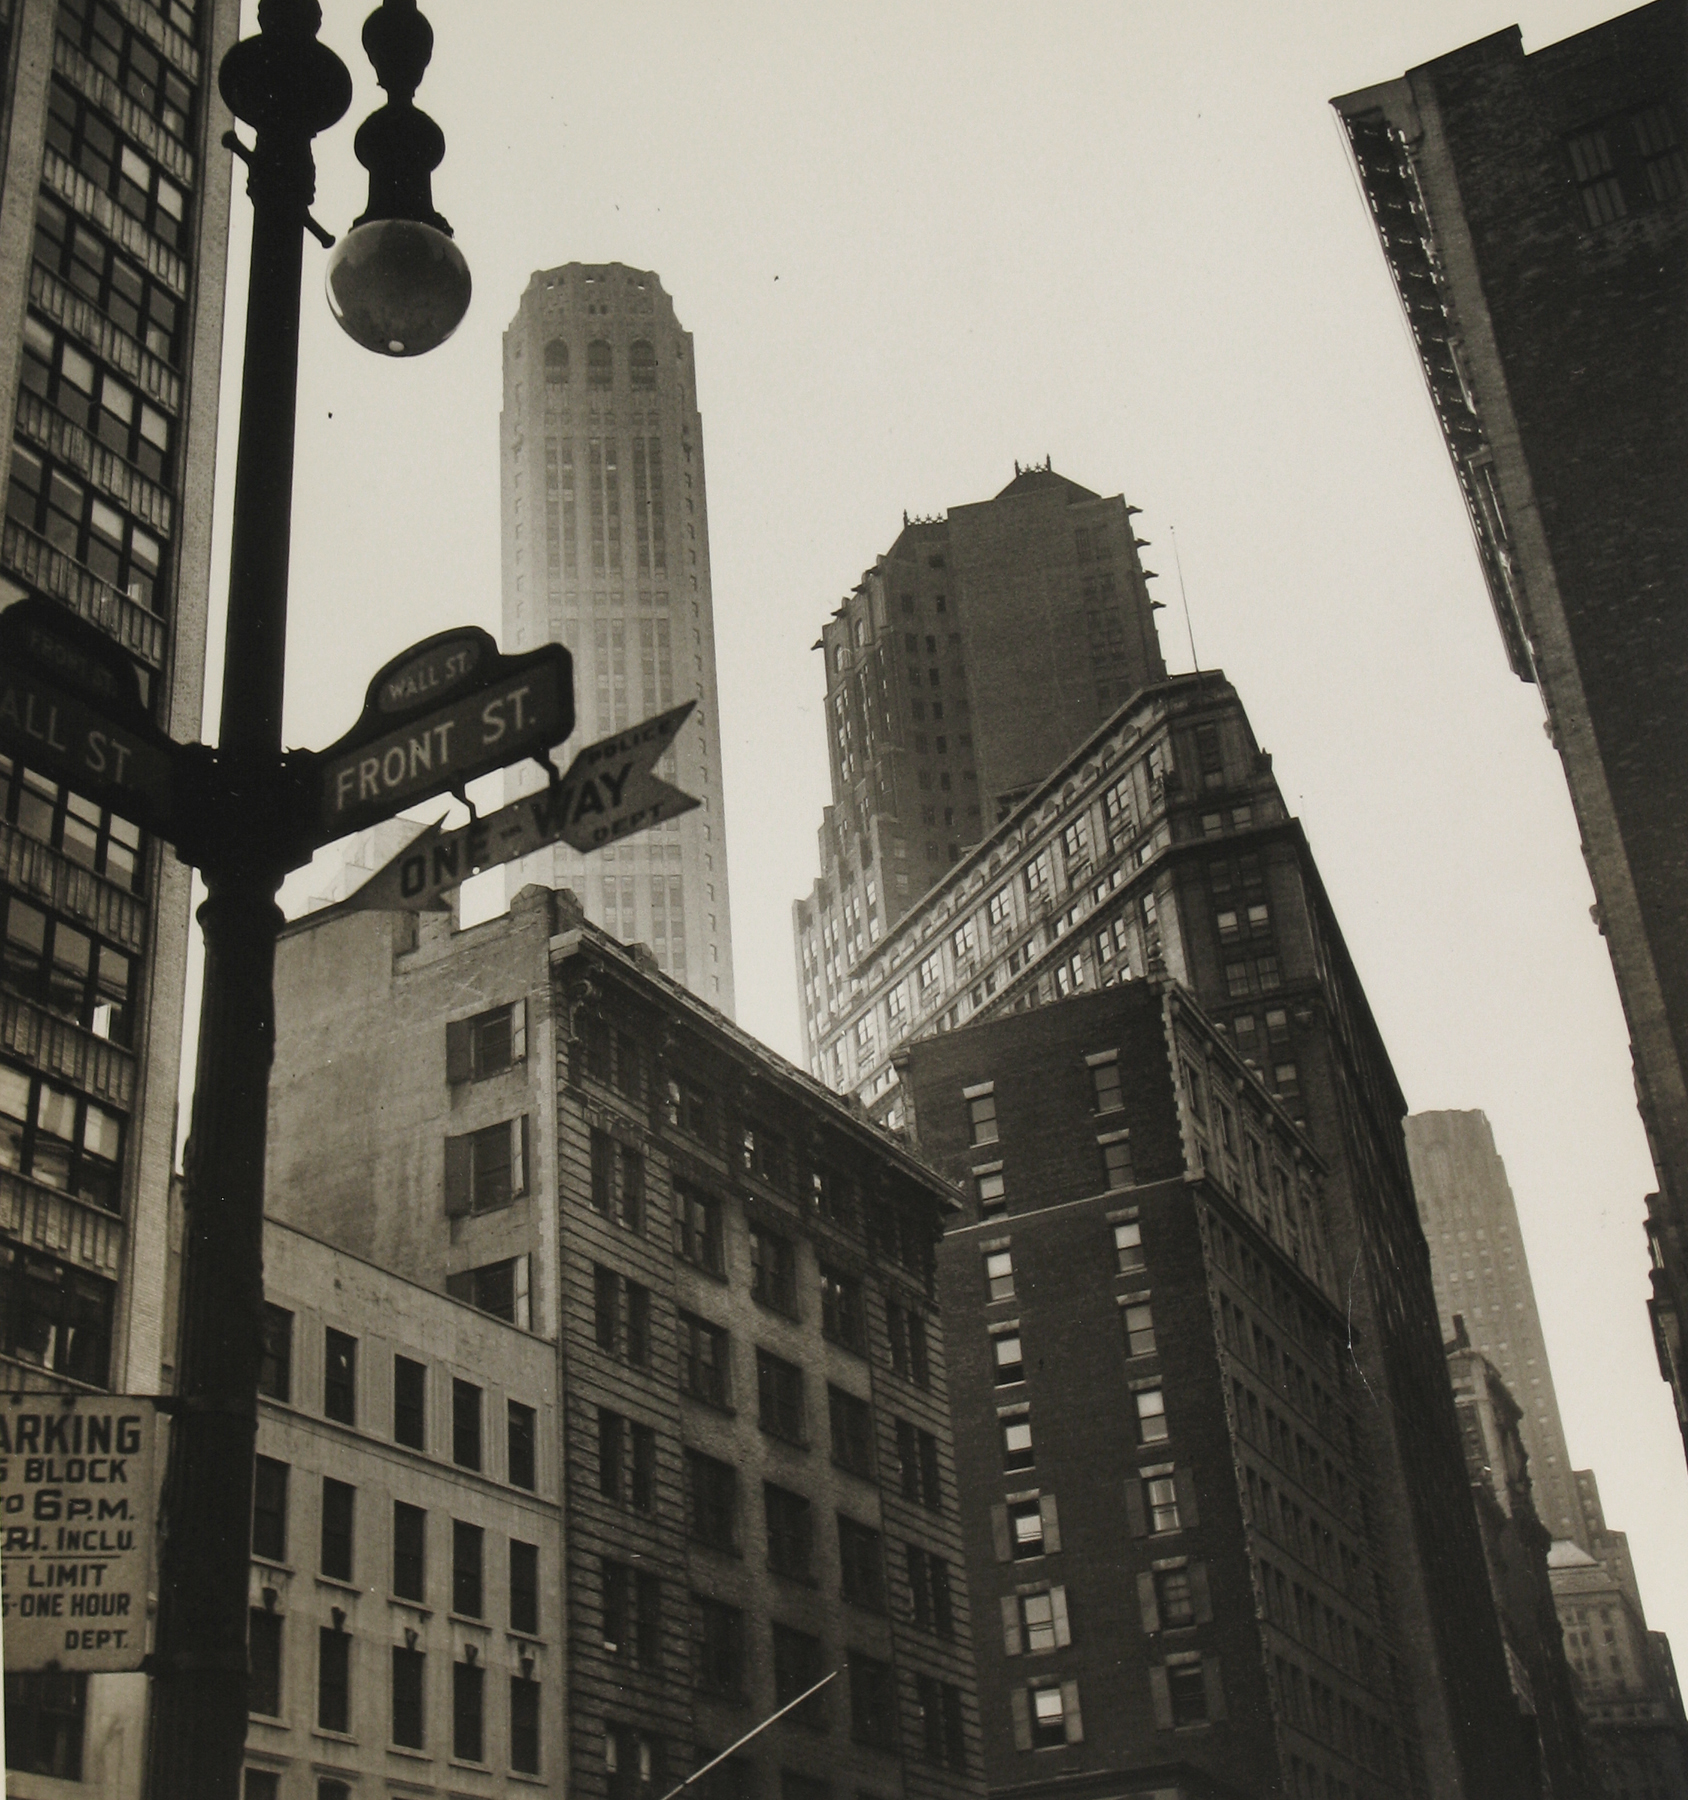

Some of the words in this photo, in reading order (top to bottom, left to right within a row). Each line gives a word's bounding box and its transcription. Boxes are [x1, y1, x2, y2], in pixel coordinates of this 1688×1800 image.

[389, 666, 439, 701] WALL
[335, 721, 455, 811] FRONT
[482, 685, 536, 745] ST.
[587, 718, 671, 767] POLICE
[24, 1458, 128, 1483] BLOCK
[0, 1526, 48, 1552] RI.
[57, 1526, 136, 1551] INCLU.
[28, 1564, 107, 1587] LIMIT
[71, 1592, 131, 1617] HOUR
[65, 1629, 128, 1650] DEPT.
